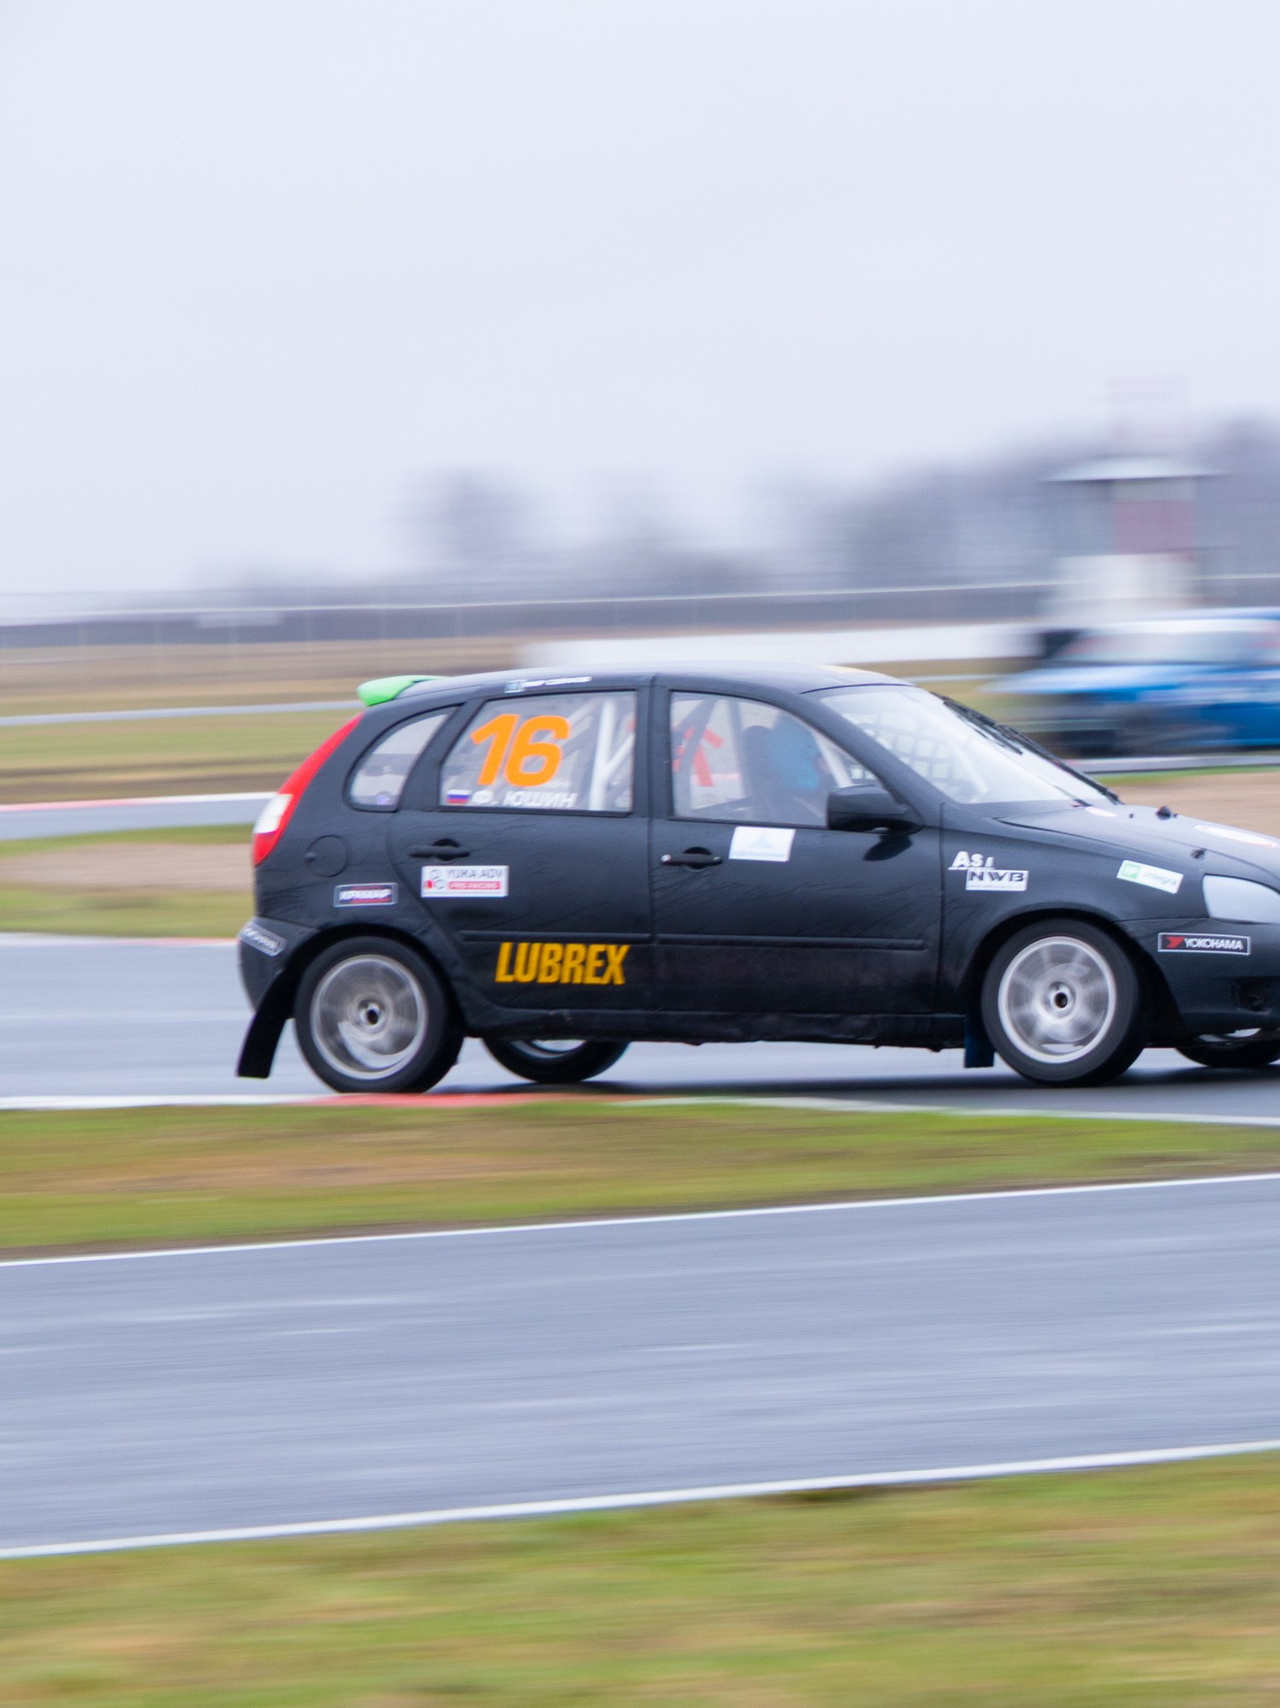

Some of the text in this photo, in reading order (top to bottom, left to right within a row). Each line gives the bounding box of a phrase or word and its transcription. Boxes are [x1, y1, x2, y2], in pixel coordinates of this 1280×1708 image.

[470, 713, 572, 788] 16
[503, 790, 579, 808] ЮШИН
[969, 871, 1025, 882] NWB
[1184, 937, 1245, 950] YOKOHAMA
[494, 941, 631, 985] LUBREX
